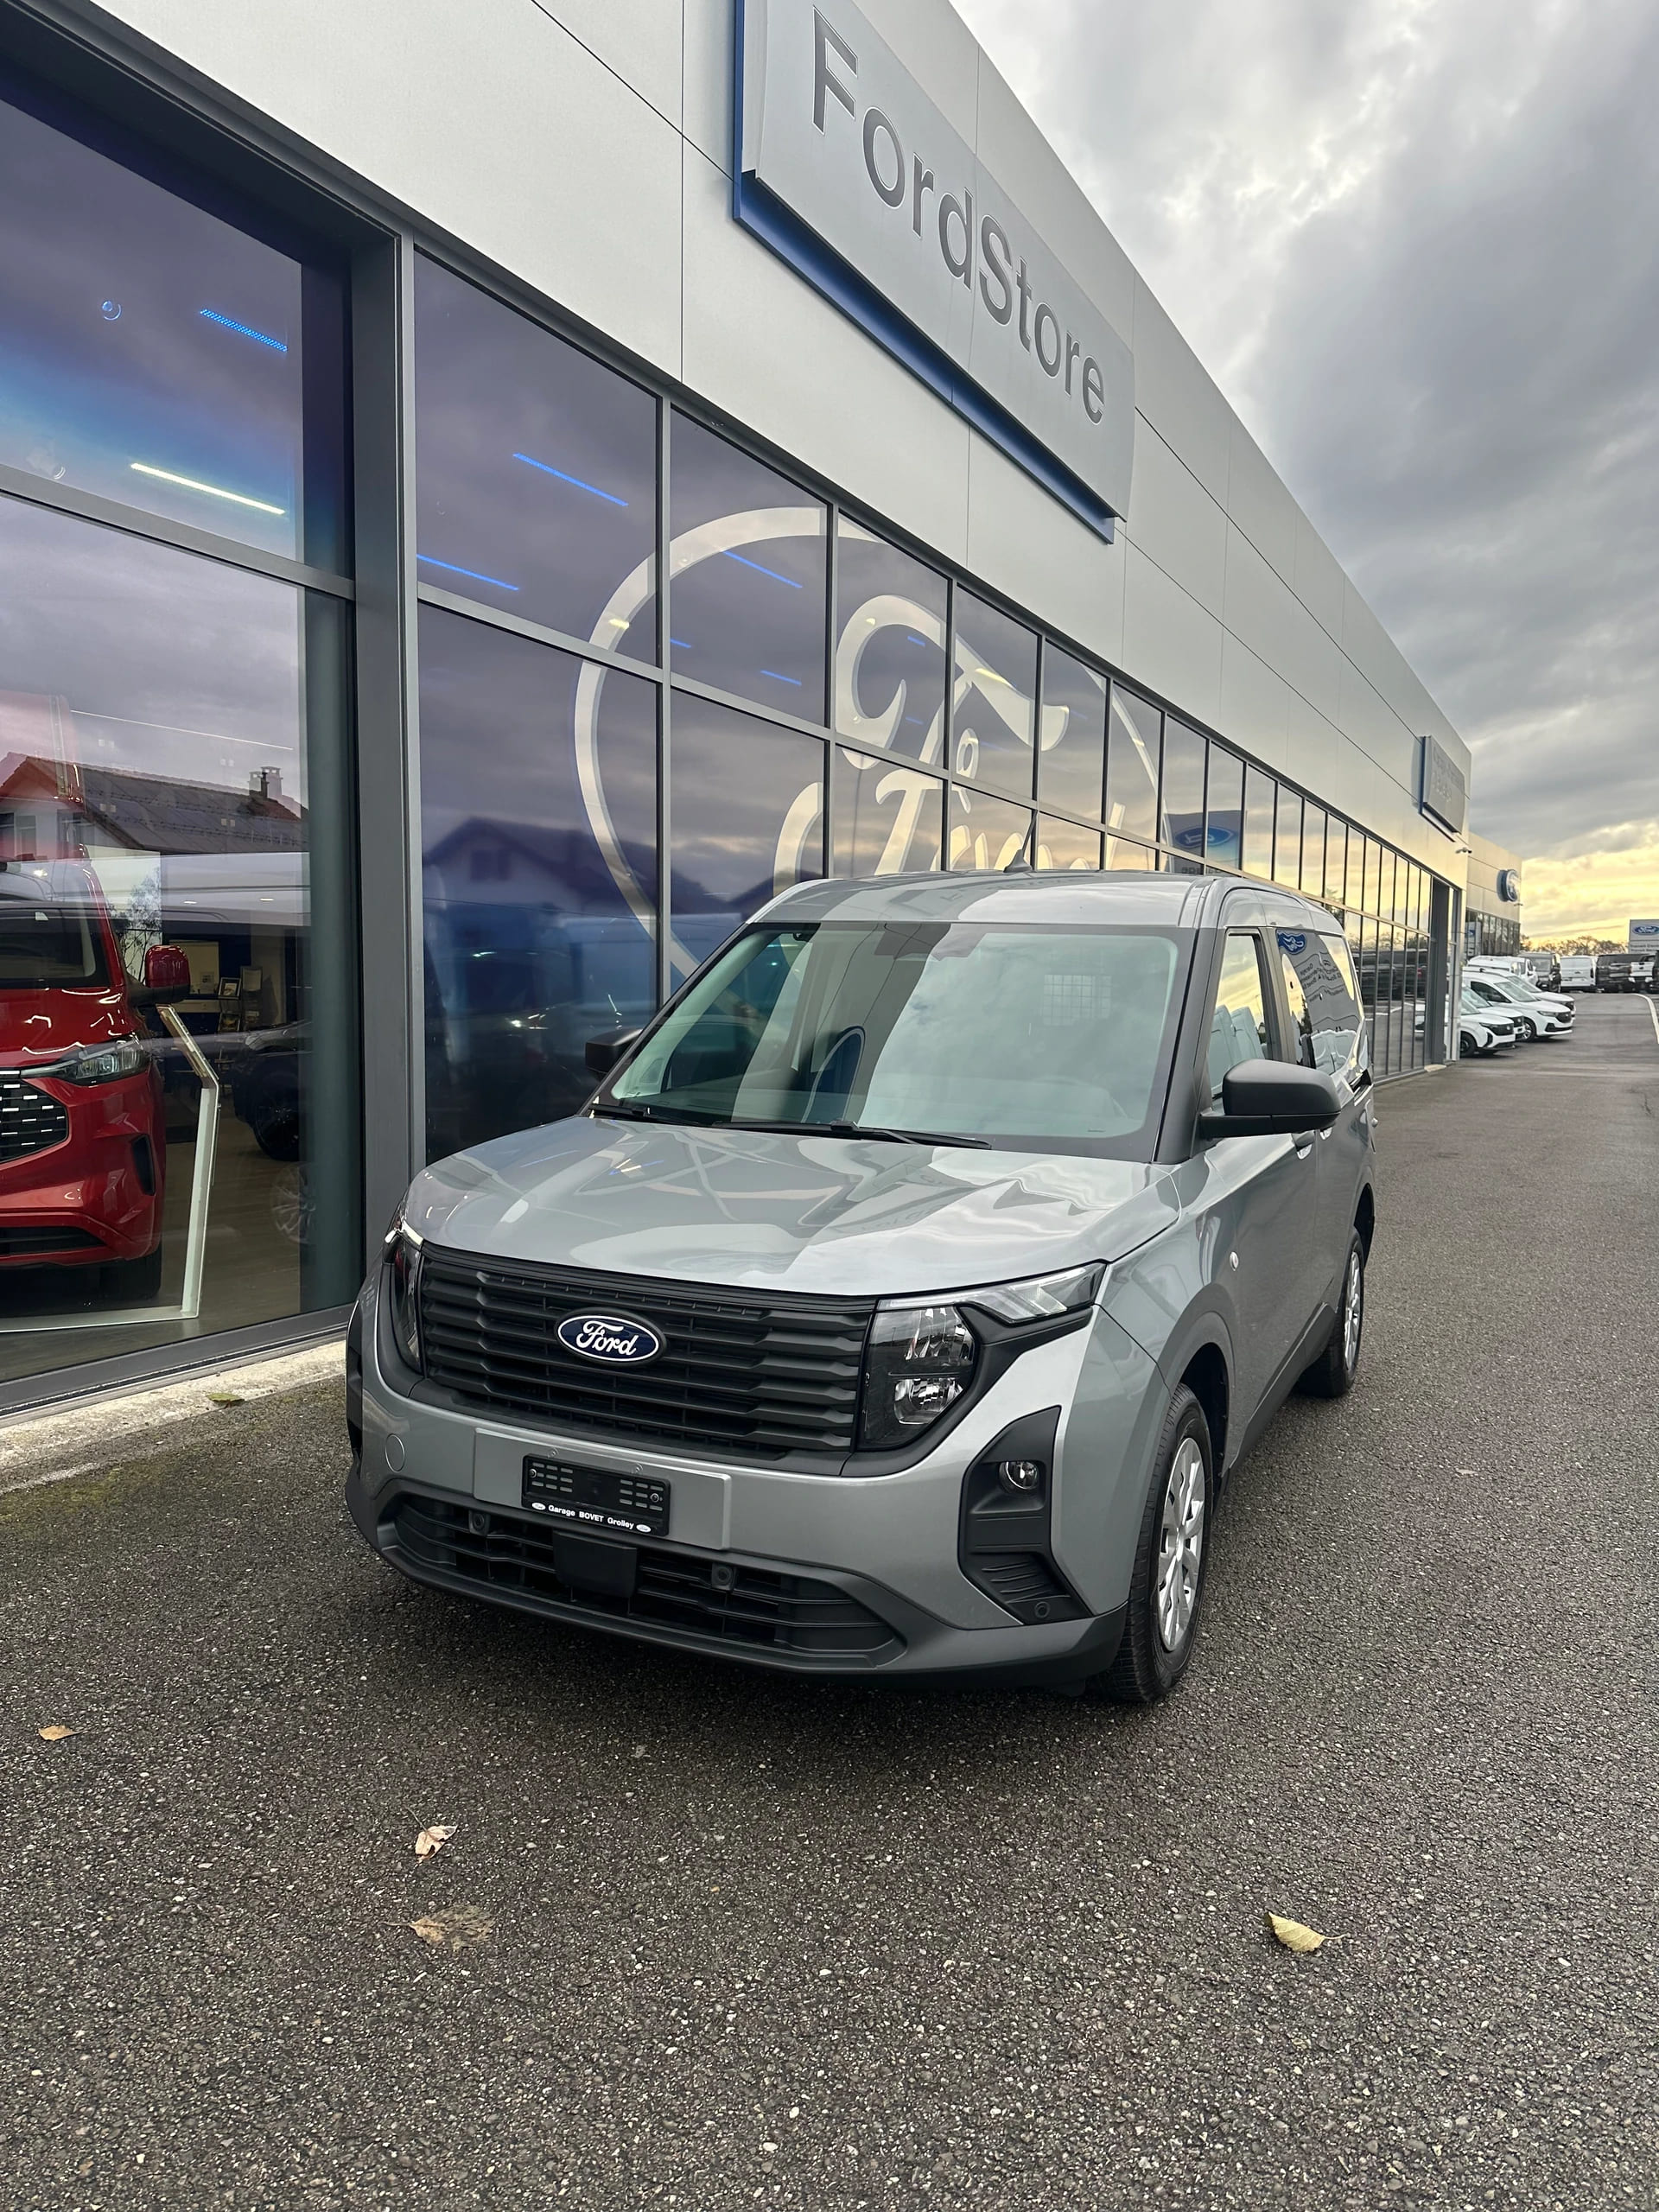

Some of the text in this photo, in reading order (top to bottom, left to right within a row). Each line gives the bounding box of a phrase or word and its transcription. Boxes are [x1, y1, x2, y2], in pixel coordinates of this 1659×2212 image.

[812, 5, 1105, 425] FordStore
[576, 1320, 639, 1356] Ford
[548, 1505, 575, 1516] Garage
[579, 1511, 604, 1522] BOVET
[607, 1517, 633, 1529] Grolley
